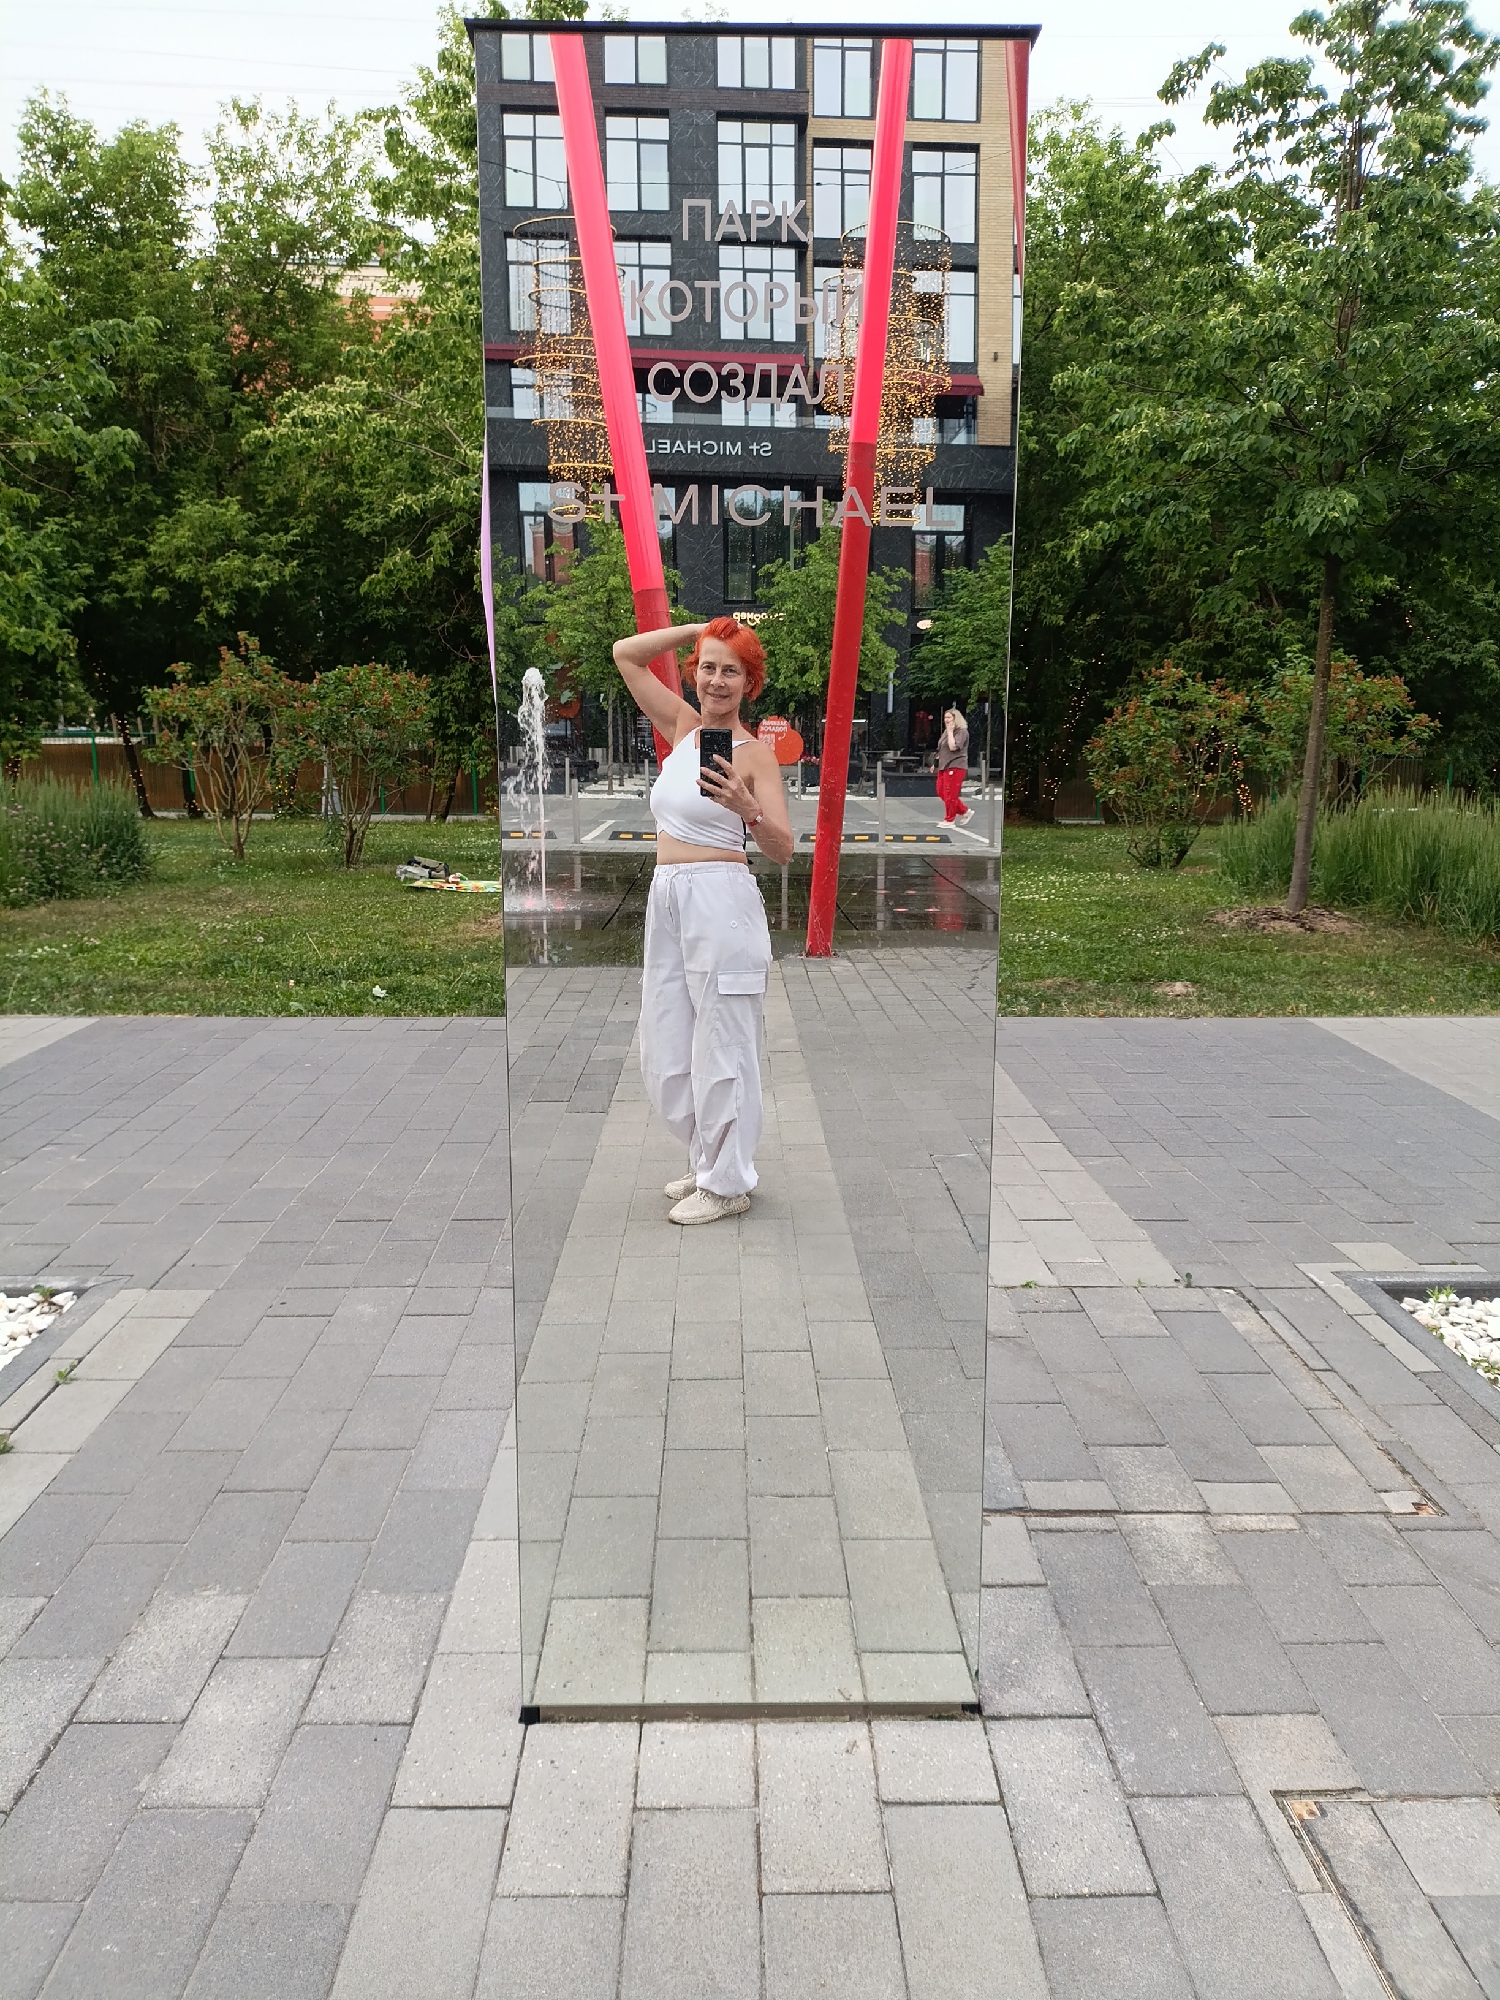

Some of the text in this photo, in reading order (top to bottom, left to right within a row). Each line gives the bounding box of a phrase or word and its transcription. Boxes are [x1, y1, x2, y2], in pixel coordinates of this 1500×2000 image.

[682, 198, 814, 244] ПАРК,
[630, 270, 864, 325] КОТОРЫЙ
[647, 361, 844, 411] СОЗДАЛ
[548, 481, 957, 527] St MICHAEL
